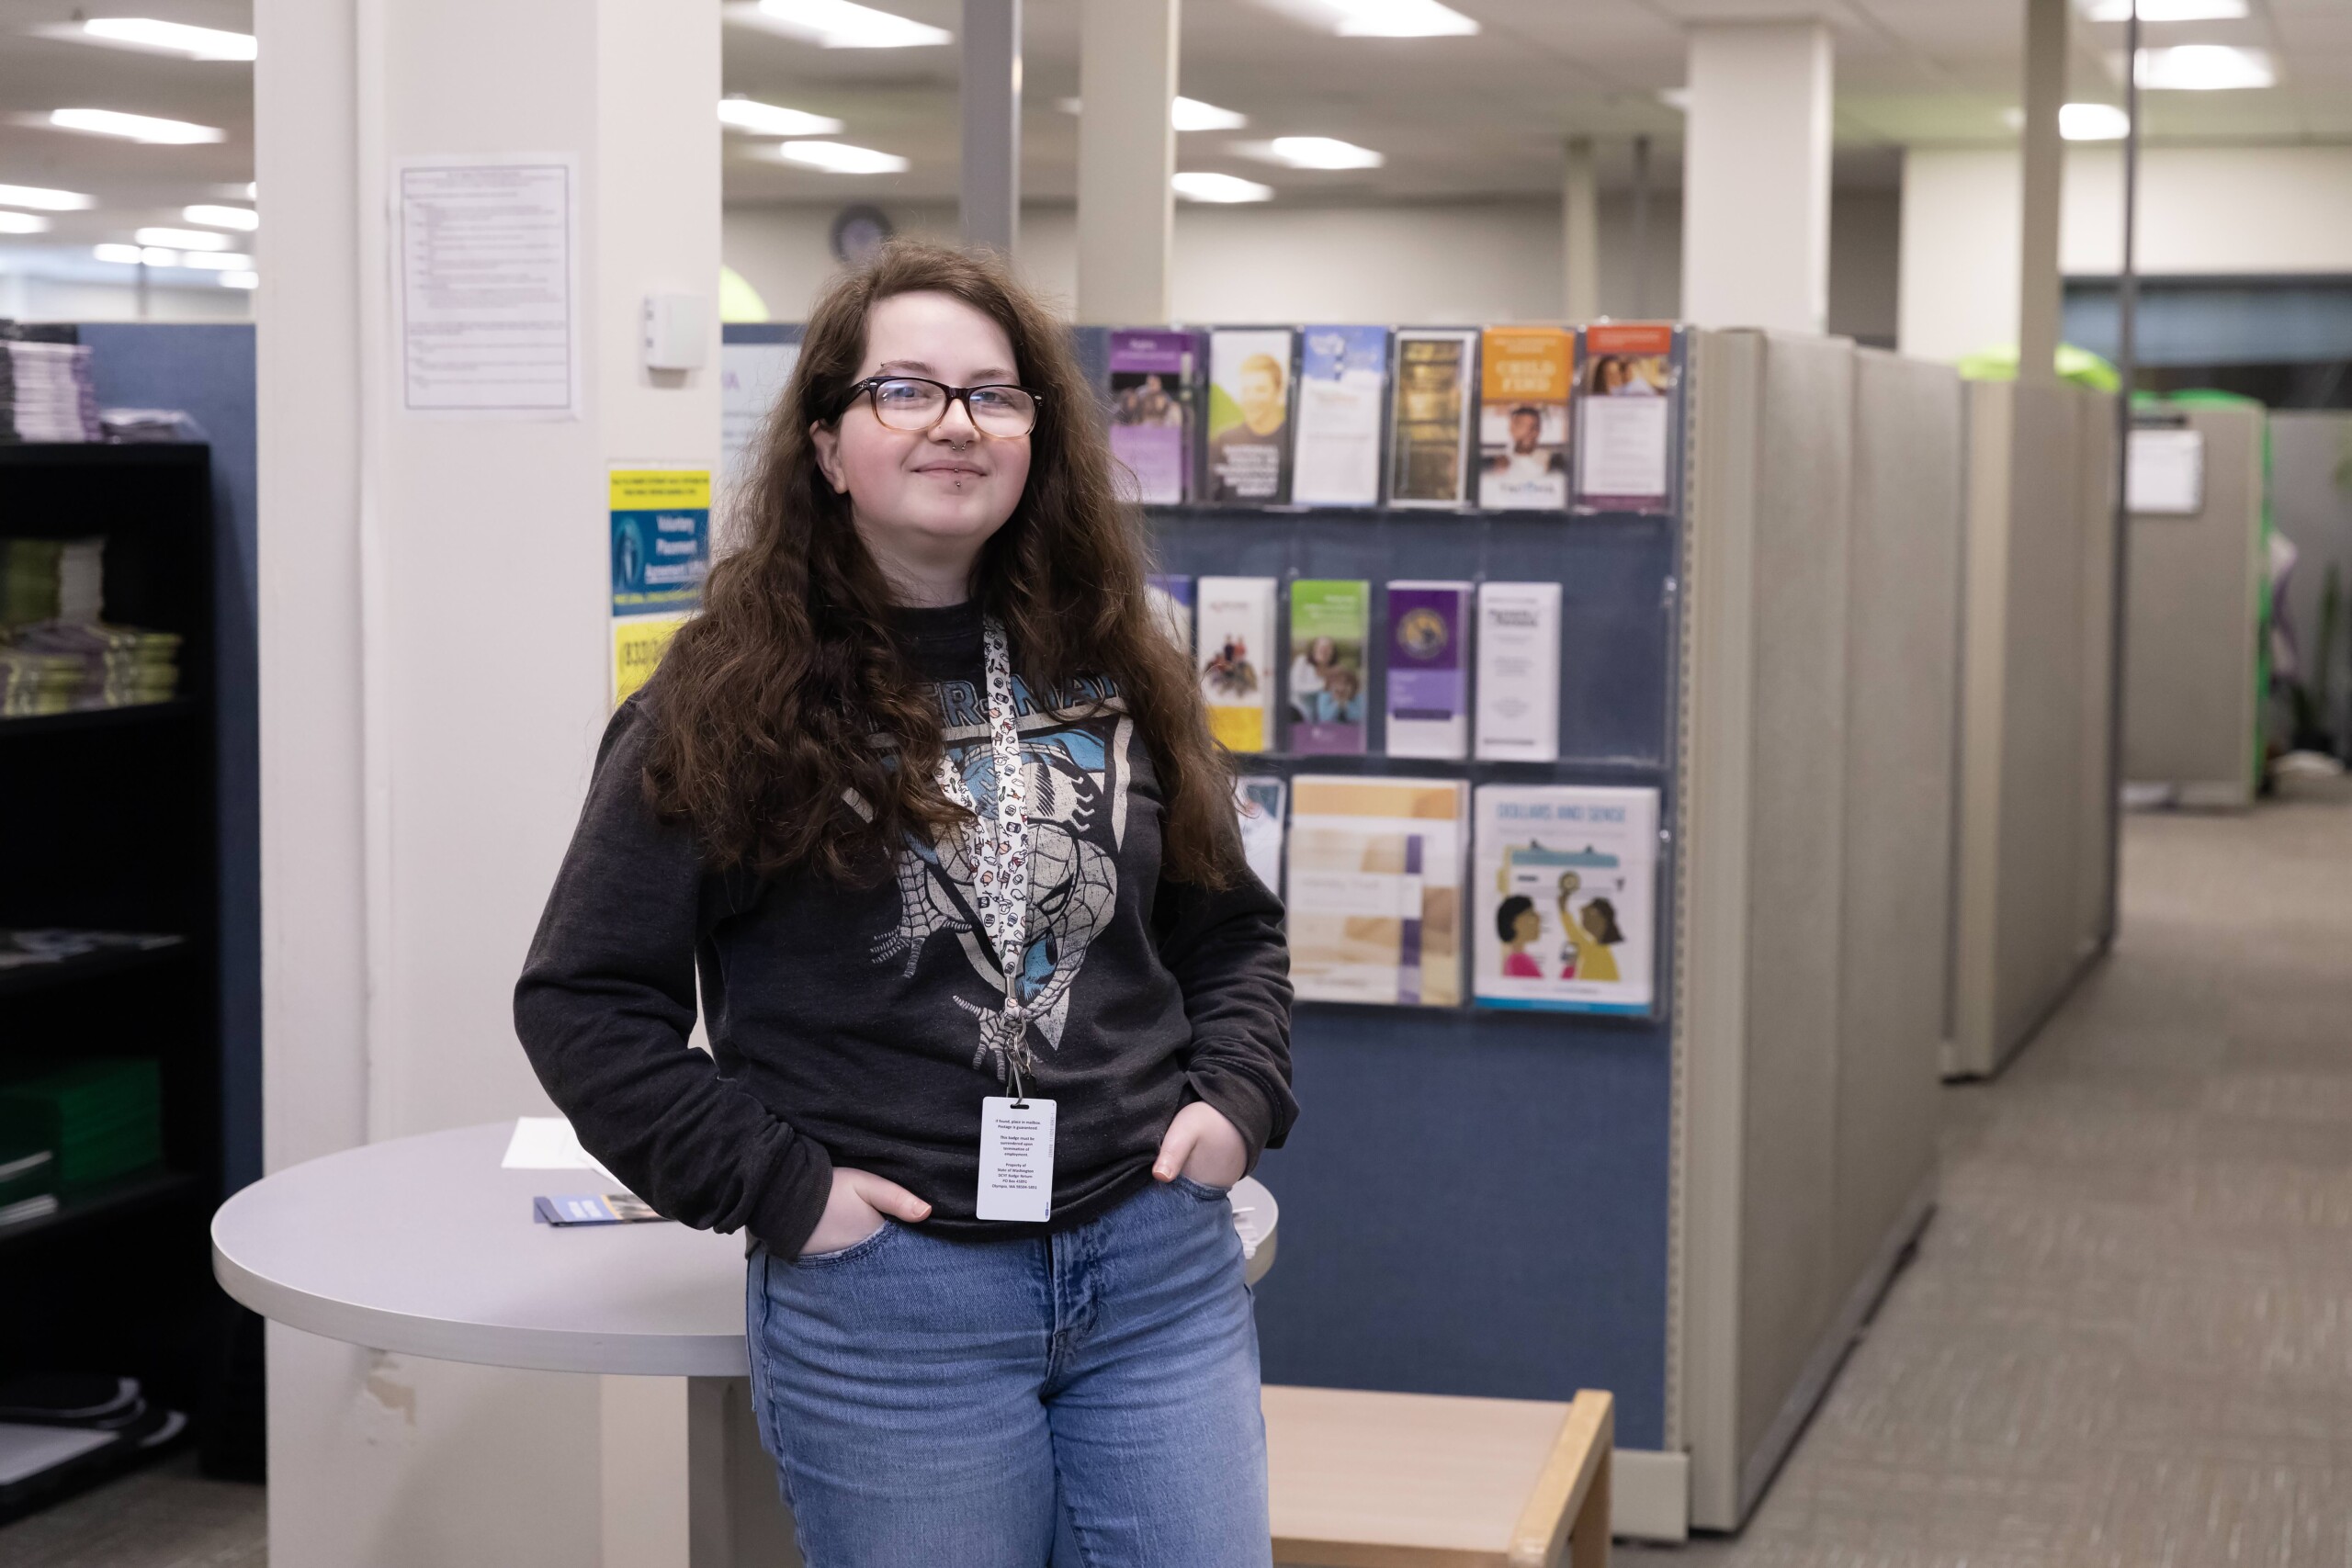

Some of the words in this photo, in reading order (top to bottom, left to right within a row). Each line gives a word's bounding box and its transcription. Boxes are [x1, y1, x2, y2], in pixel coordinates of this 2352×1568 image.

[1496, 801, 1553, 820] DOLLARS
[1556, 803, 1585, 820] AND
[1588, 805, 1627, 823] SENSE
